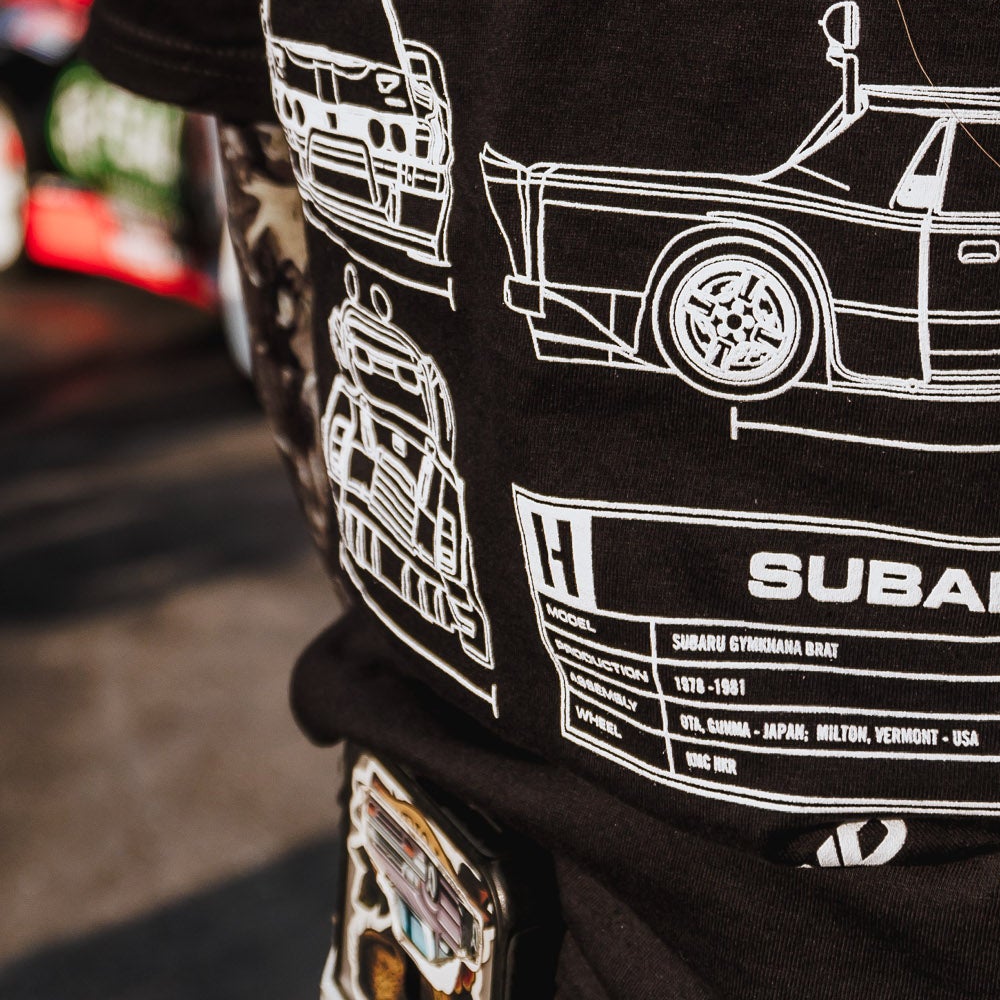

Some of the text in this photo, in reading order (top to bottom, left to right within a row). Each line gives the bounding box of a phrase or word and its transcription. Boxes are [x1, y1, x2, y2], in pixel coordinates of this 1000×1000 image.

[545, 603, 597, 634] MODEL
[554, 638, 649, 683] PRODUCTION
[672, 633, 839, 659] SUBARU GYMKHANA BRAT
[570, 671, 638, 712] ASSEMBLY
[575, 705, 623, 739] WHEEL
[875, 726, 939, 745] VERMONT
[952, 729, 979, 747] USA
